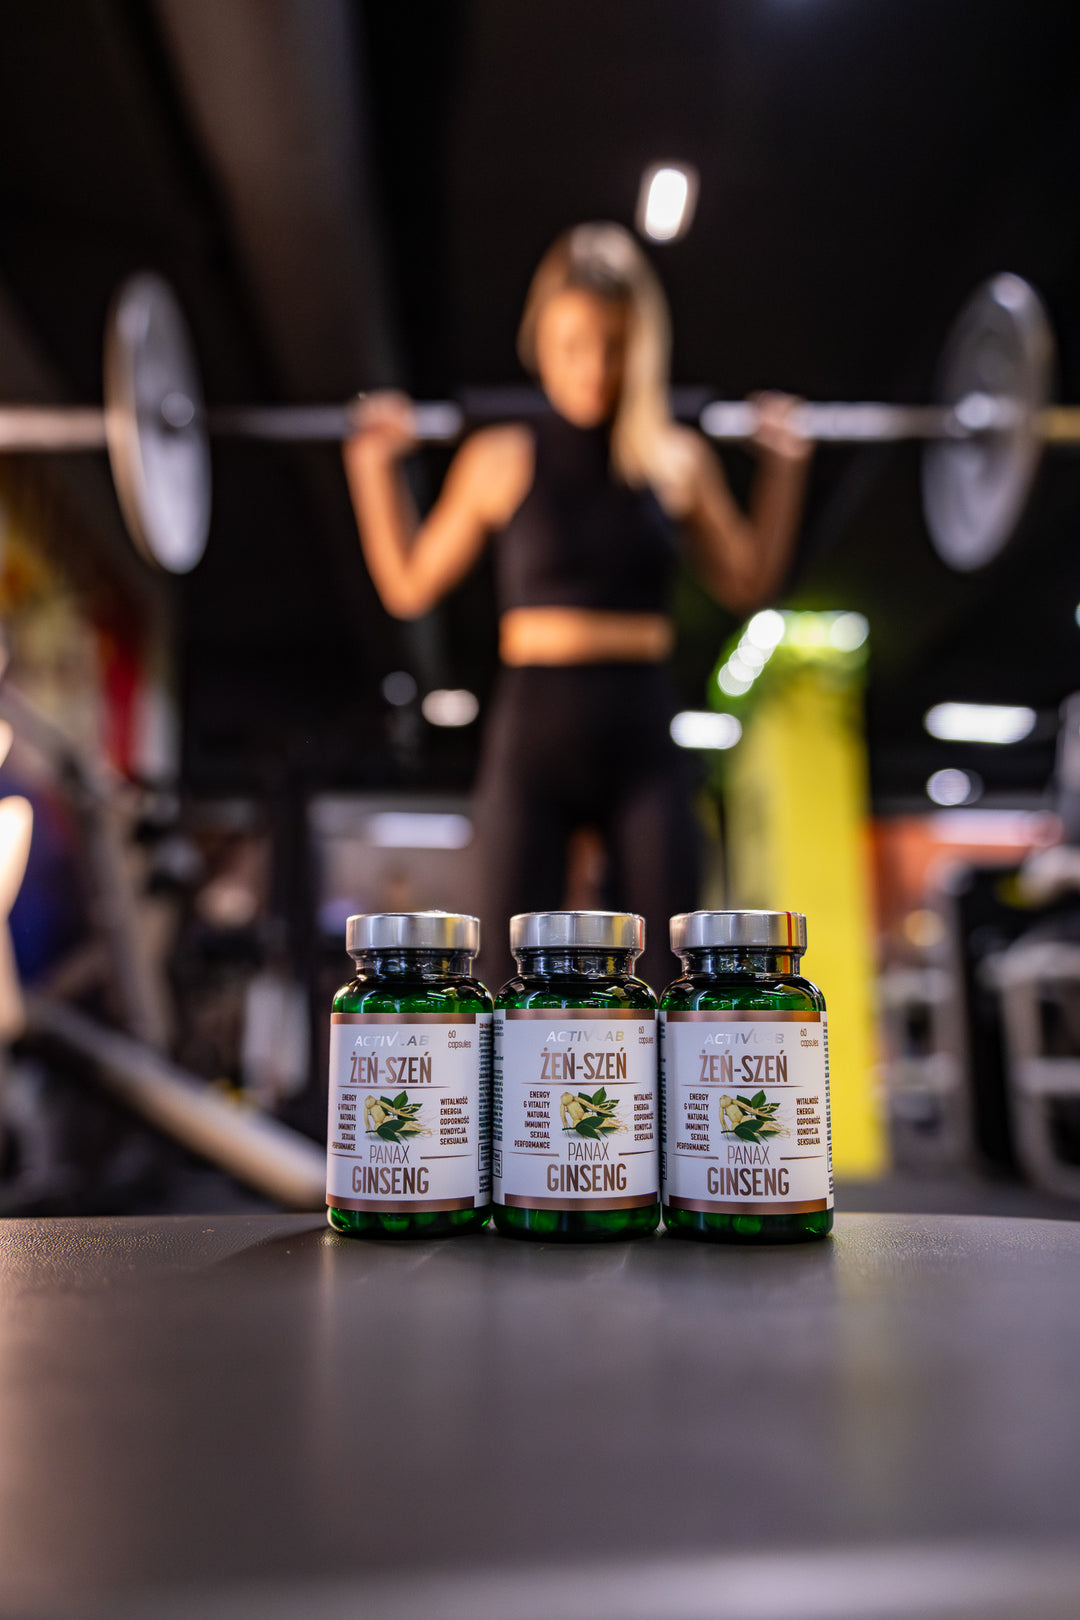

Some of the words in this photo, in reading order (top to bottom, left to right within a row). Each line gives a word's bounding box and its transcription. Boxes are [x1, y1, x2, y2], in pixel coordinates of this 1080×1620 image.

[448, 1030, 456, 1039] 60
[800, 1028, 807, 1037] 60
[448, 1040, 471, 1049] capsules
[350, 1051, 432, 1083] ŻEŃ-SZEŃ
[540, 1047, 626, 1079] ŻEŃ-SZEŃ
[700, 1050, 787, 1082] ŻEŃ-SZEŃ
[440, 1117, 469, 1125] ODPORNOŚĆ
[440, 1137, 468, 1145] SEKSUALNA
[514, 1140, 550, 1149] PERFORMANCE
[677, 1143, 710, 1151] PERFORMANCE
[370, 1145, 409, 1164] PANAX
[568, 1142, 609, 1161] PANAX
[728, 1145, 770, 1165] PANAX
[352, 1166, 429, 1194] GINSENG
[547, 1163, 626, 1192] GINSENG
[707, 1167, 789, 1196] GINSENG
